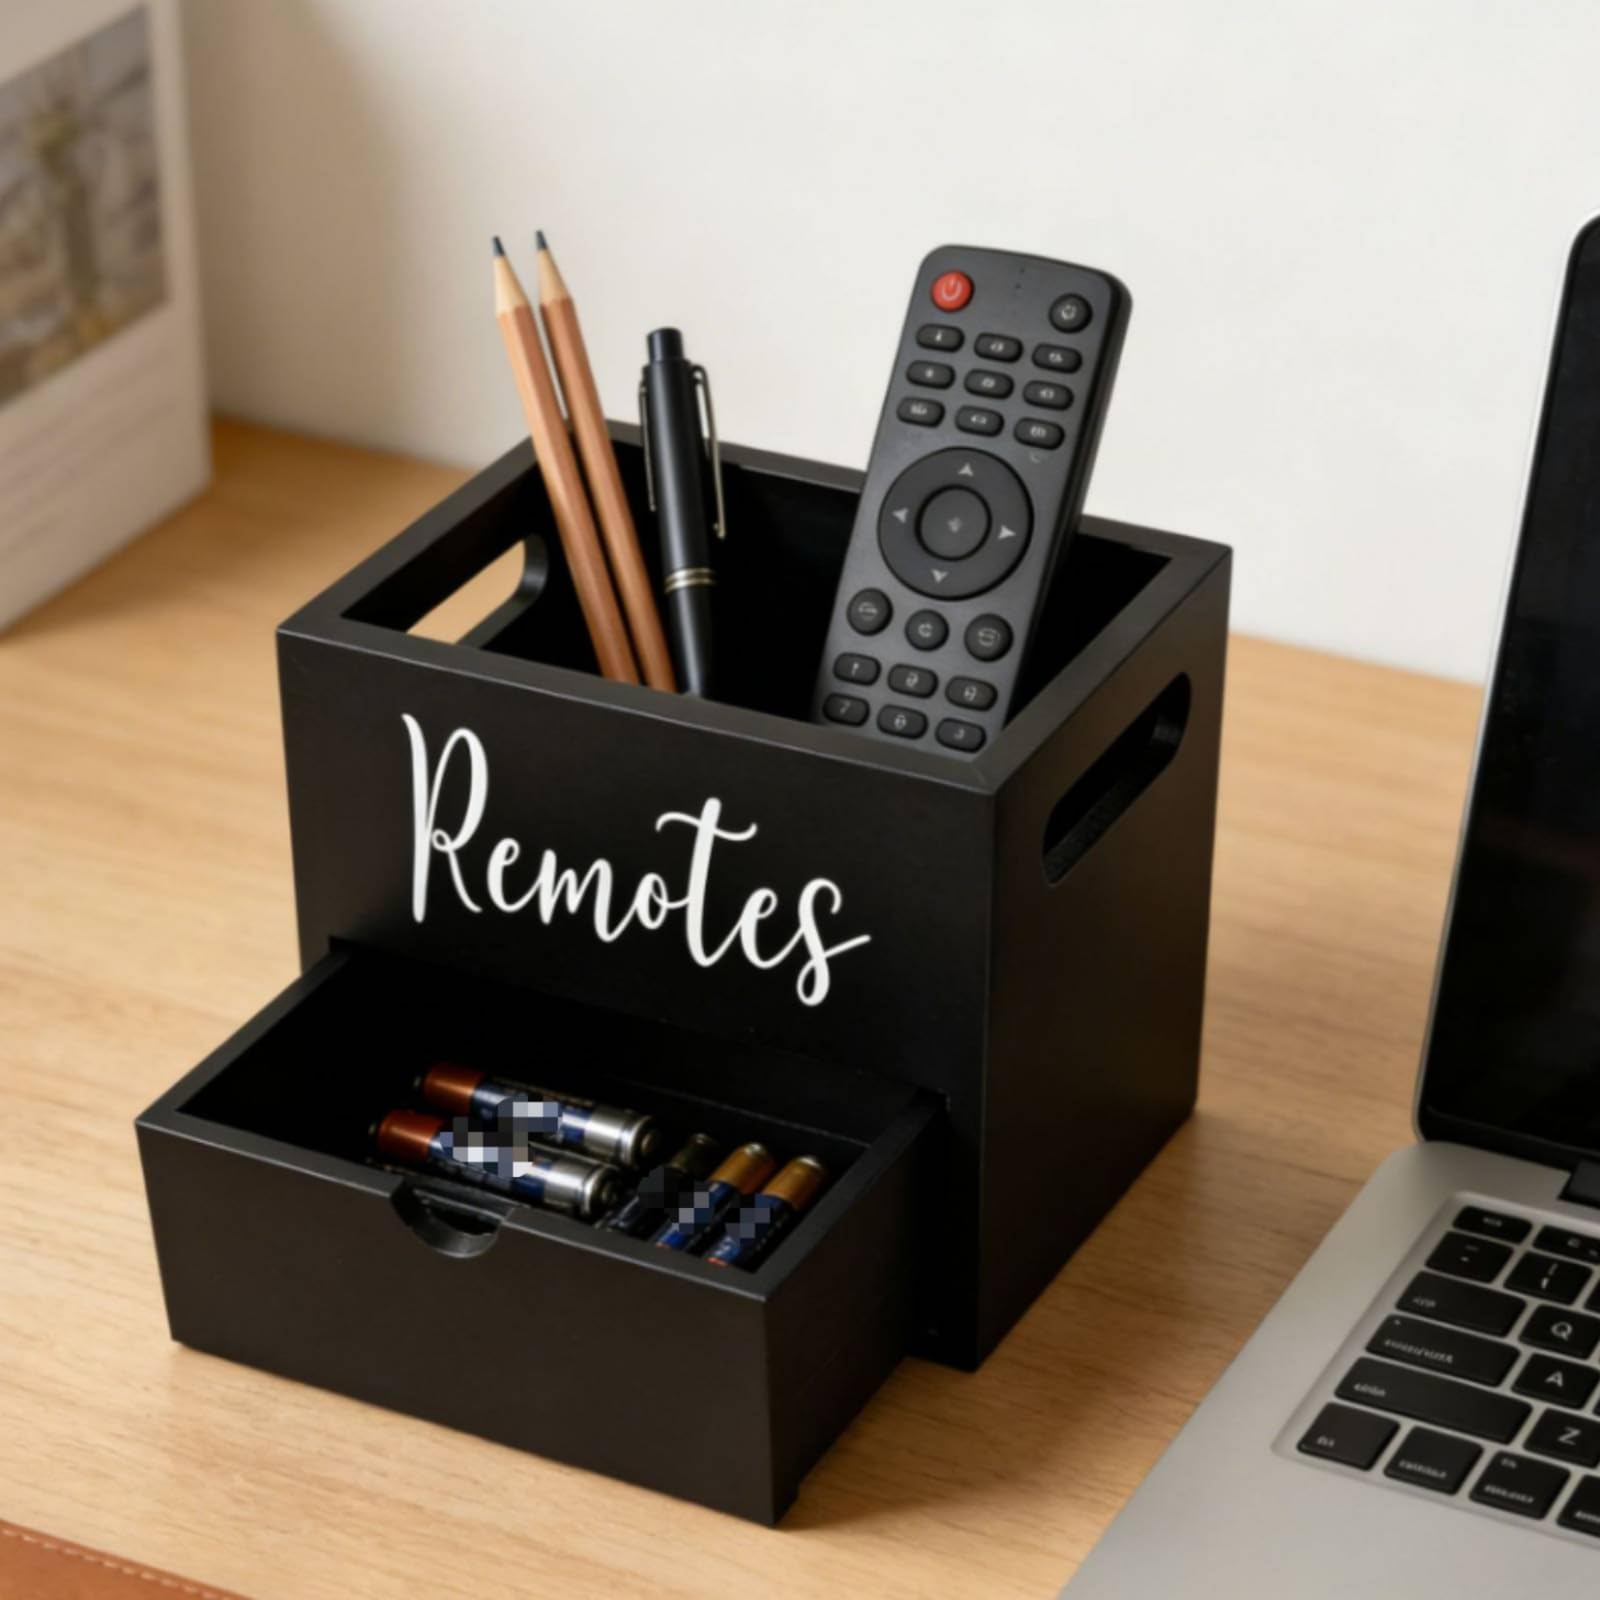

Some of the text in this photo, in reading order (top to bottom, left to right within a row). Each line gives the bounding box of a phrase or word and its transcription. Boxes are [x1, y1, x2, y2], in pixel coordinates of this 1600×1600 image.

[401, 713, 871, 1006] Remotes
[1551, 1321, 1573, 1340] Q
[1545, 1371, 1564, 1388] A
[1558, 1427, 1581, 1444] Z
